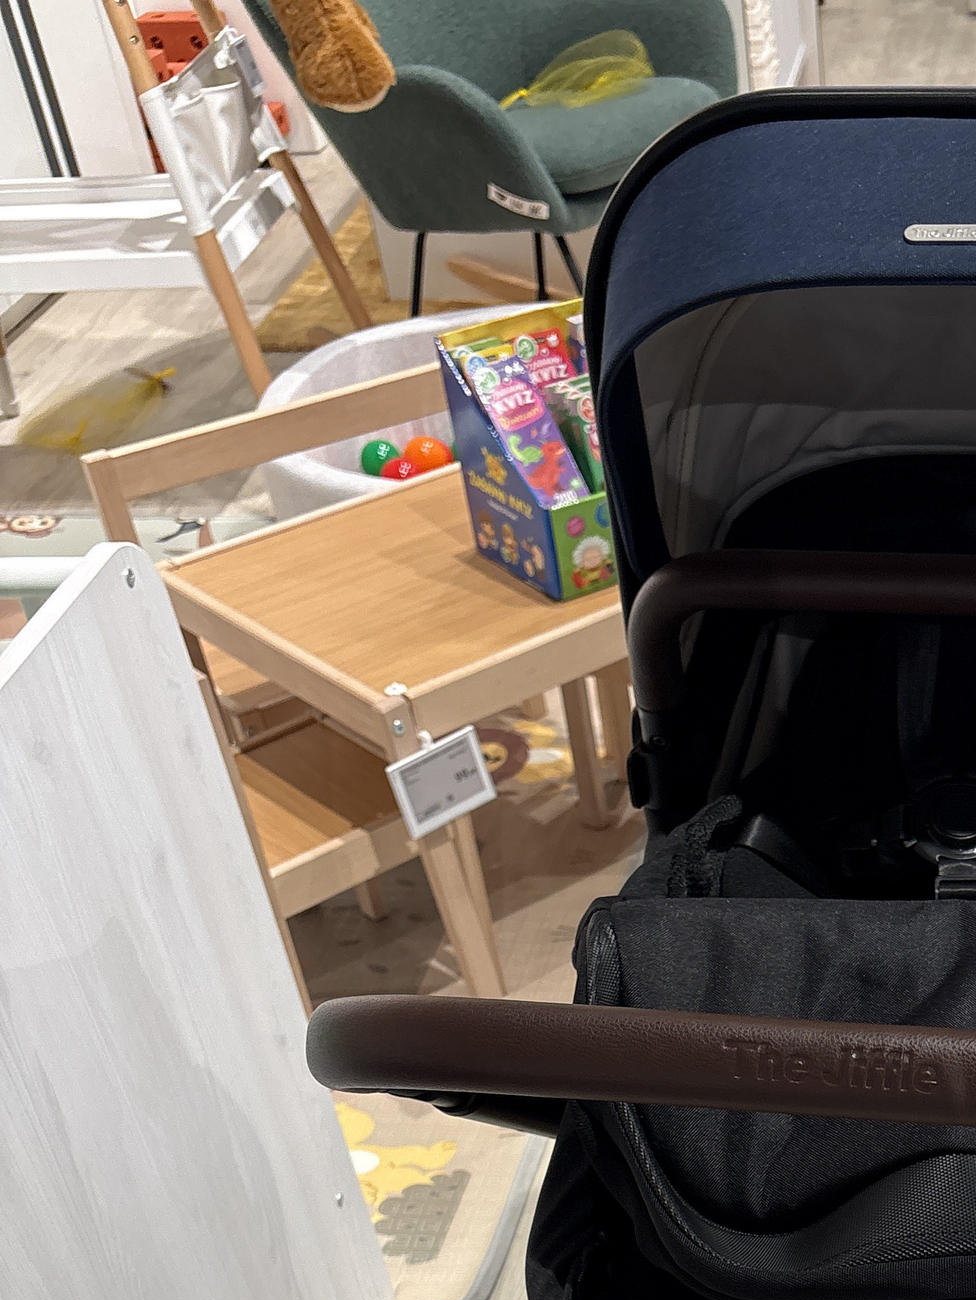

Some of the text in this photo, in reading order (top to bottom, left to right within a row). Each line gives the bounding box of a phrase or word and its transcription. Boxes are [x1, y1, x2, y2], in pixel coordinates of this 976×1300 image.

[493, 390, 535, 415] KVIZ
[724, 1038, 948, 1095] The Jiffle
